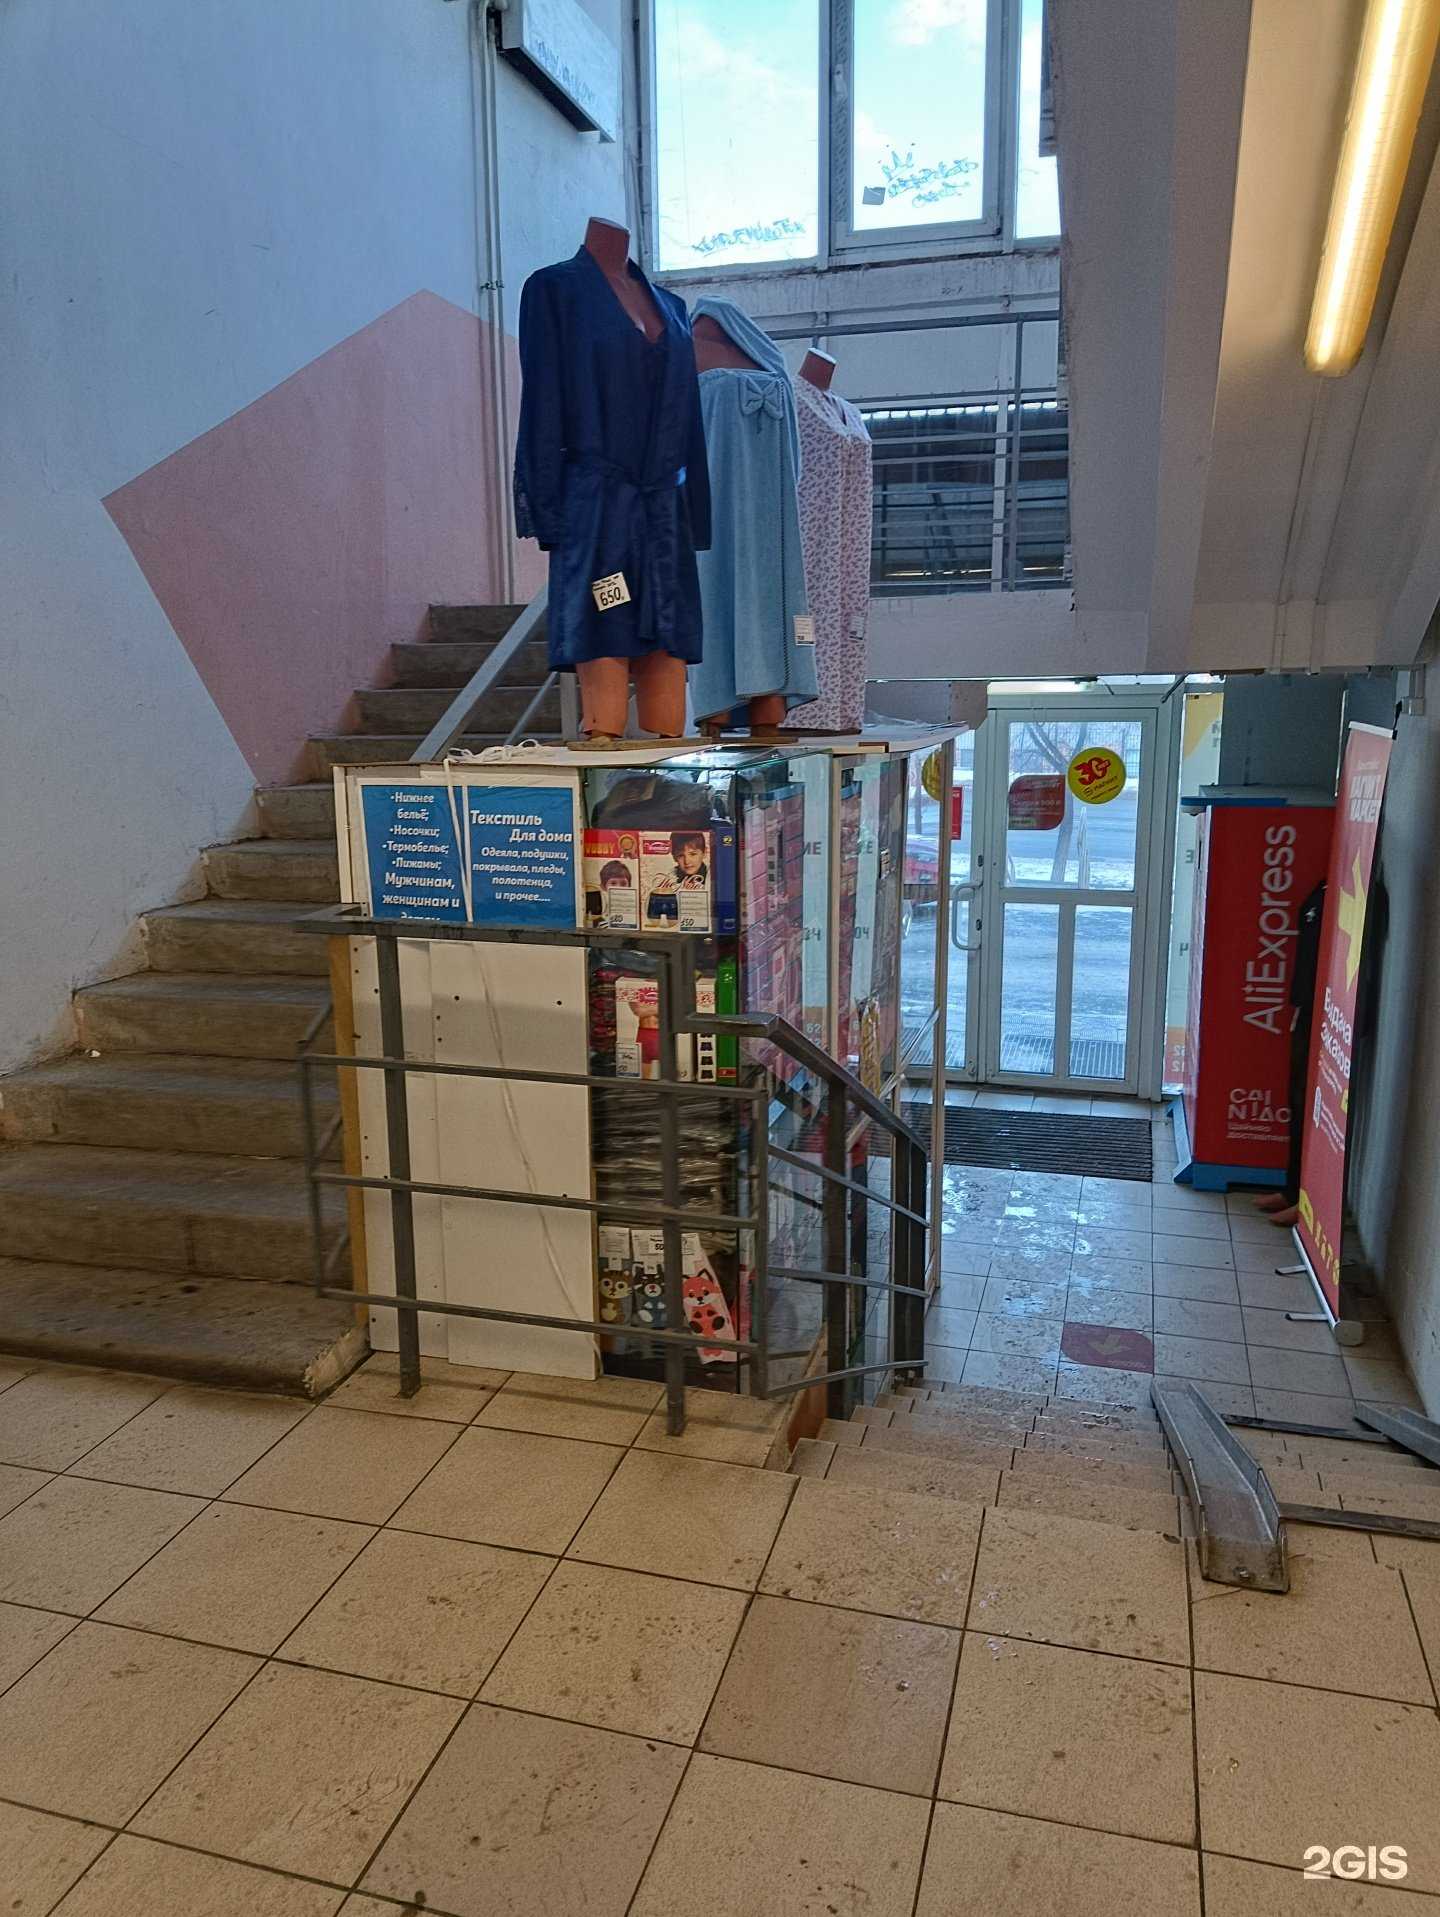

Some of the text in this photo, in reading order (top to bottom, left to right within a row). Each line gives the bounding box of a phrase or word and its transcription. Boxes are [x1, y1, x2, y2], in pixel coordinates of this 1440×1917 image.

[470, 810, 542, 826] Текстиль
[509, 828, 573, 843] Для дома
[481, 847, 569, 861] Одеяла, подушки,
[472, 863, 566, 875] покрывала, пледы,
[385, 872, 455, 889] Мужчинам,
[492, 876, 553, 888] полотенца,
[382, 894, 460, 908] женщинам и
[495, 891, 502, 900] и
[1242, 825, 1299, 1034] AliExpress
